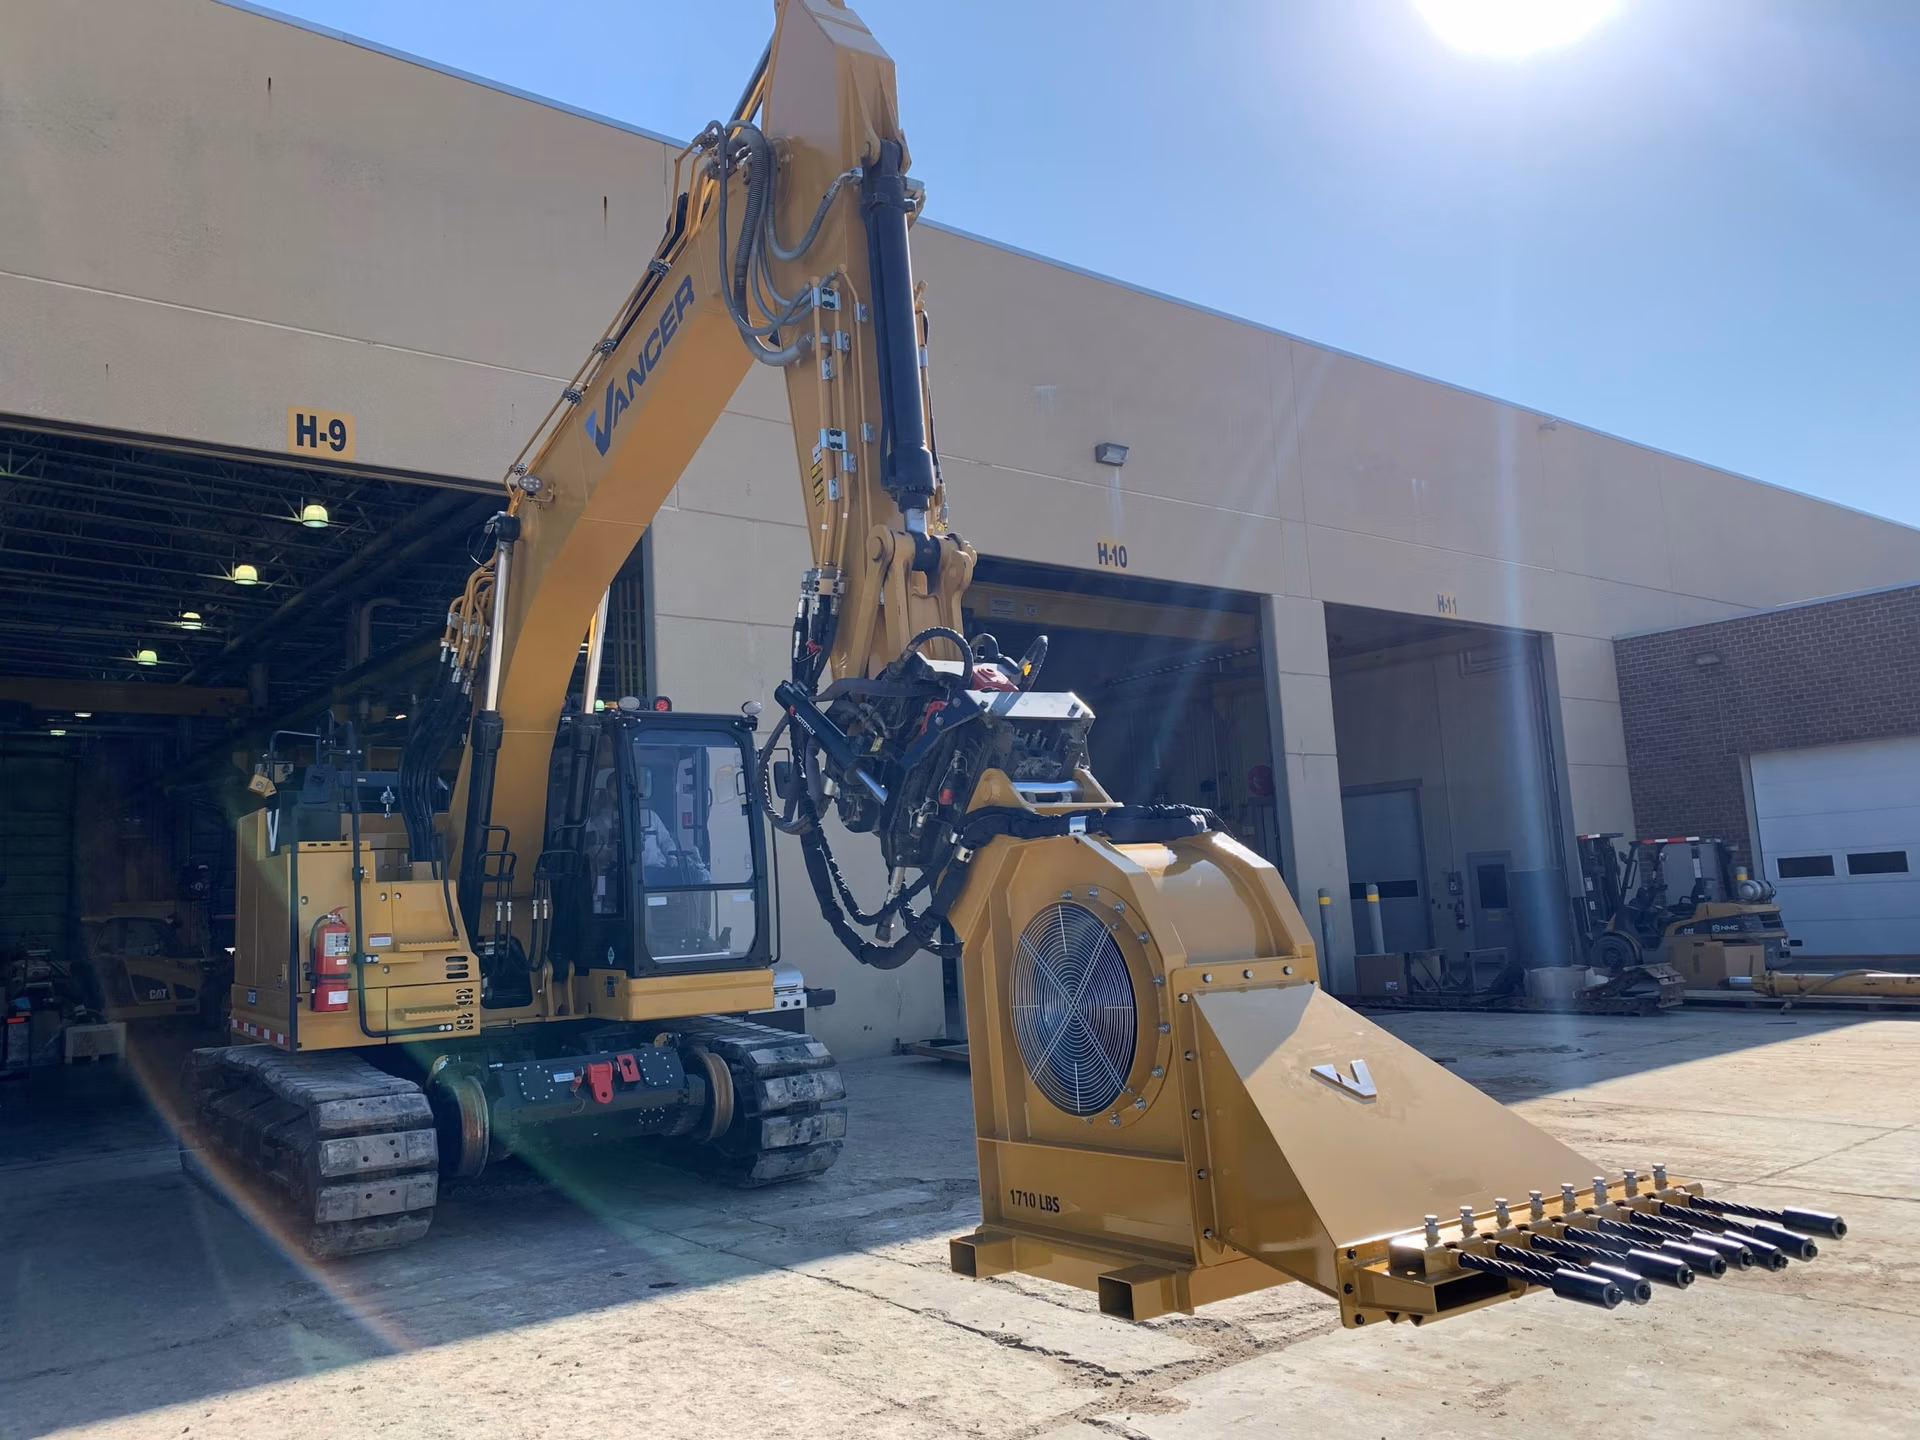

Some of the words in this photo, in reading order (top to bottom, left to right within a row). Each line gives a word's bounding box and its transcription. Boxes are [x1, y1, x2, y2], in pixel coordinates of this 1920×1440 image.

[584, 274, 695, 457] VANCER
[296, 413, 347, 452] H-9
[1097, 542, 1128, 568] H-10
[1437, 594, 1457, 614] H-11
[795, 712, 816, 735] ROTOTILT
[150, 988, 168, 1000] CAT
[1009, 1189, 1036, 1208] 1710
[1039, 1193, 1060, 1213] LBS
